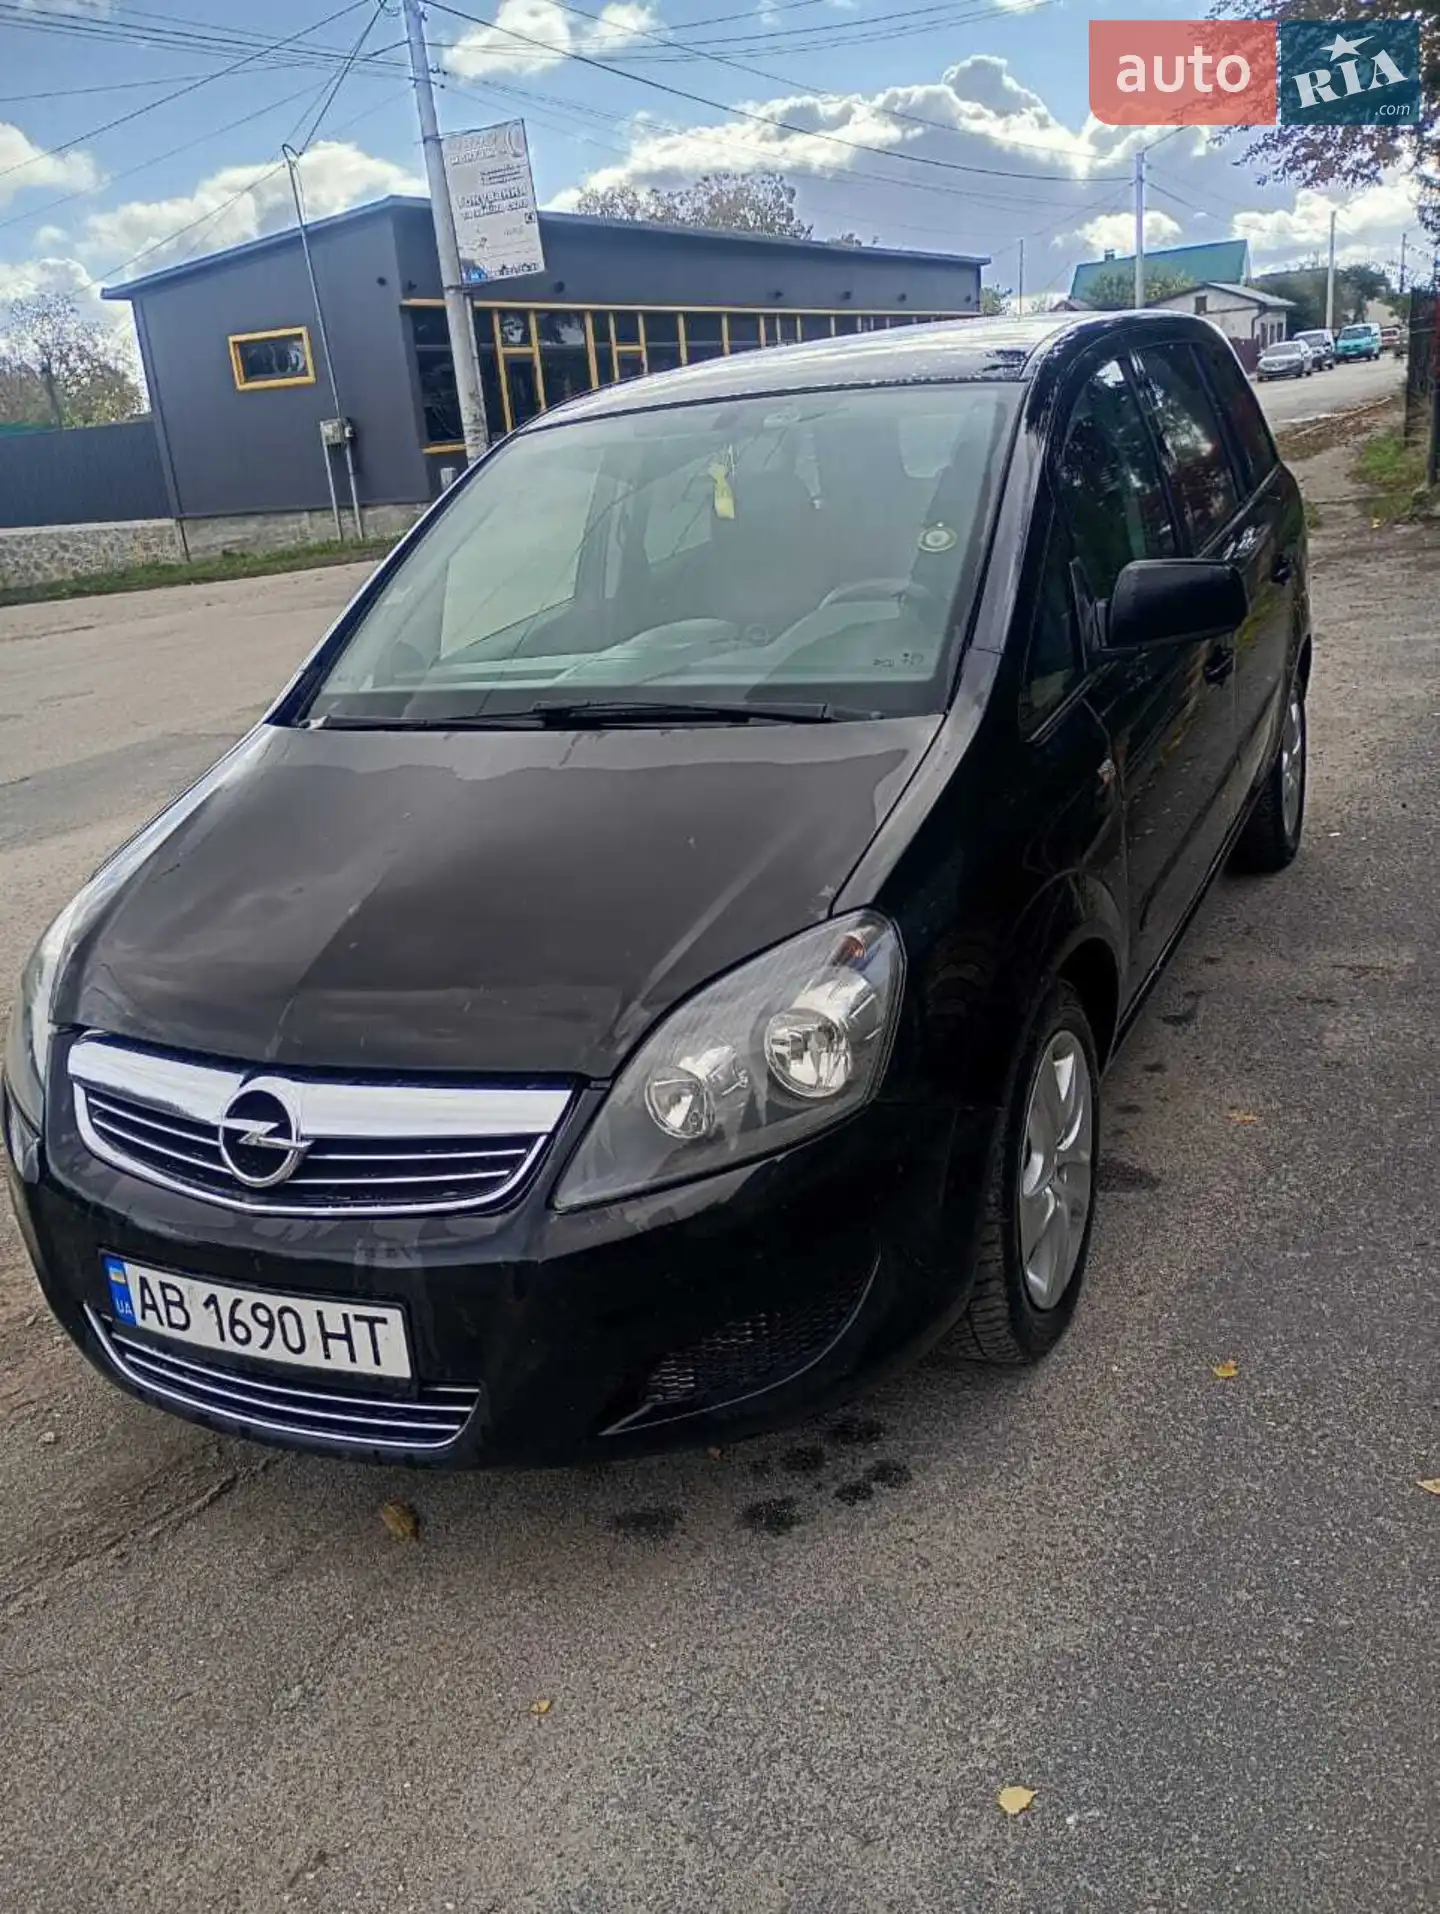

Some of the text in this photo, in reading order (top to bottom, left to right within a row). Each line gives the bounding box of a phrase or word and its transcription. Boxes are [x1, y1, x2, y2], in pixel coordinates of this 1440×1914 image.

[115, 1299, 133, 1316] UA
[138, 1275, 388, 1366] AB 1690 HT
